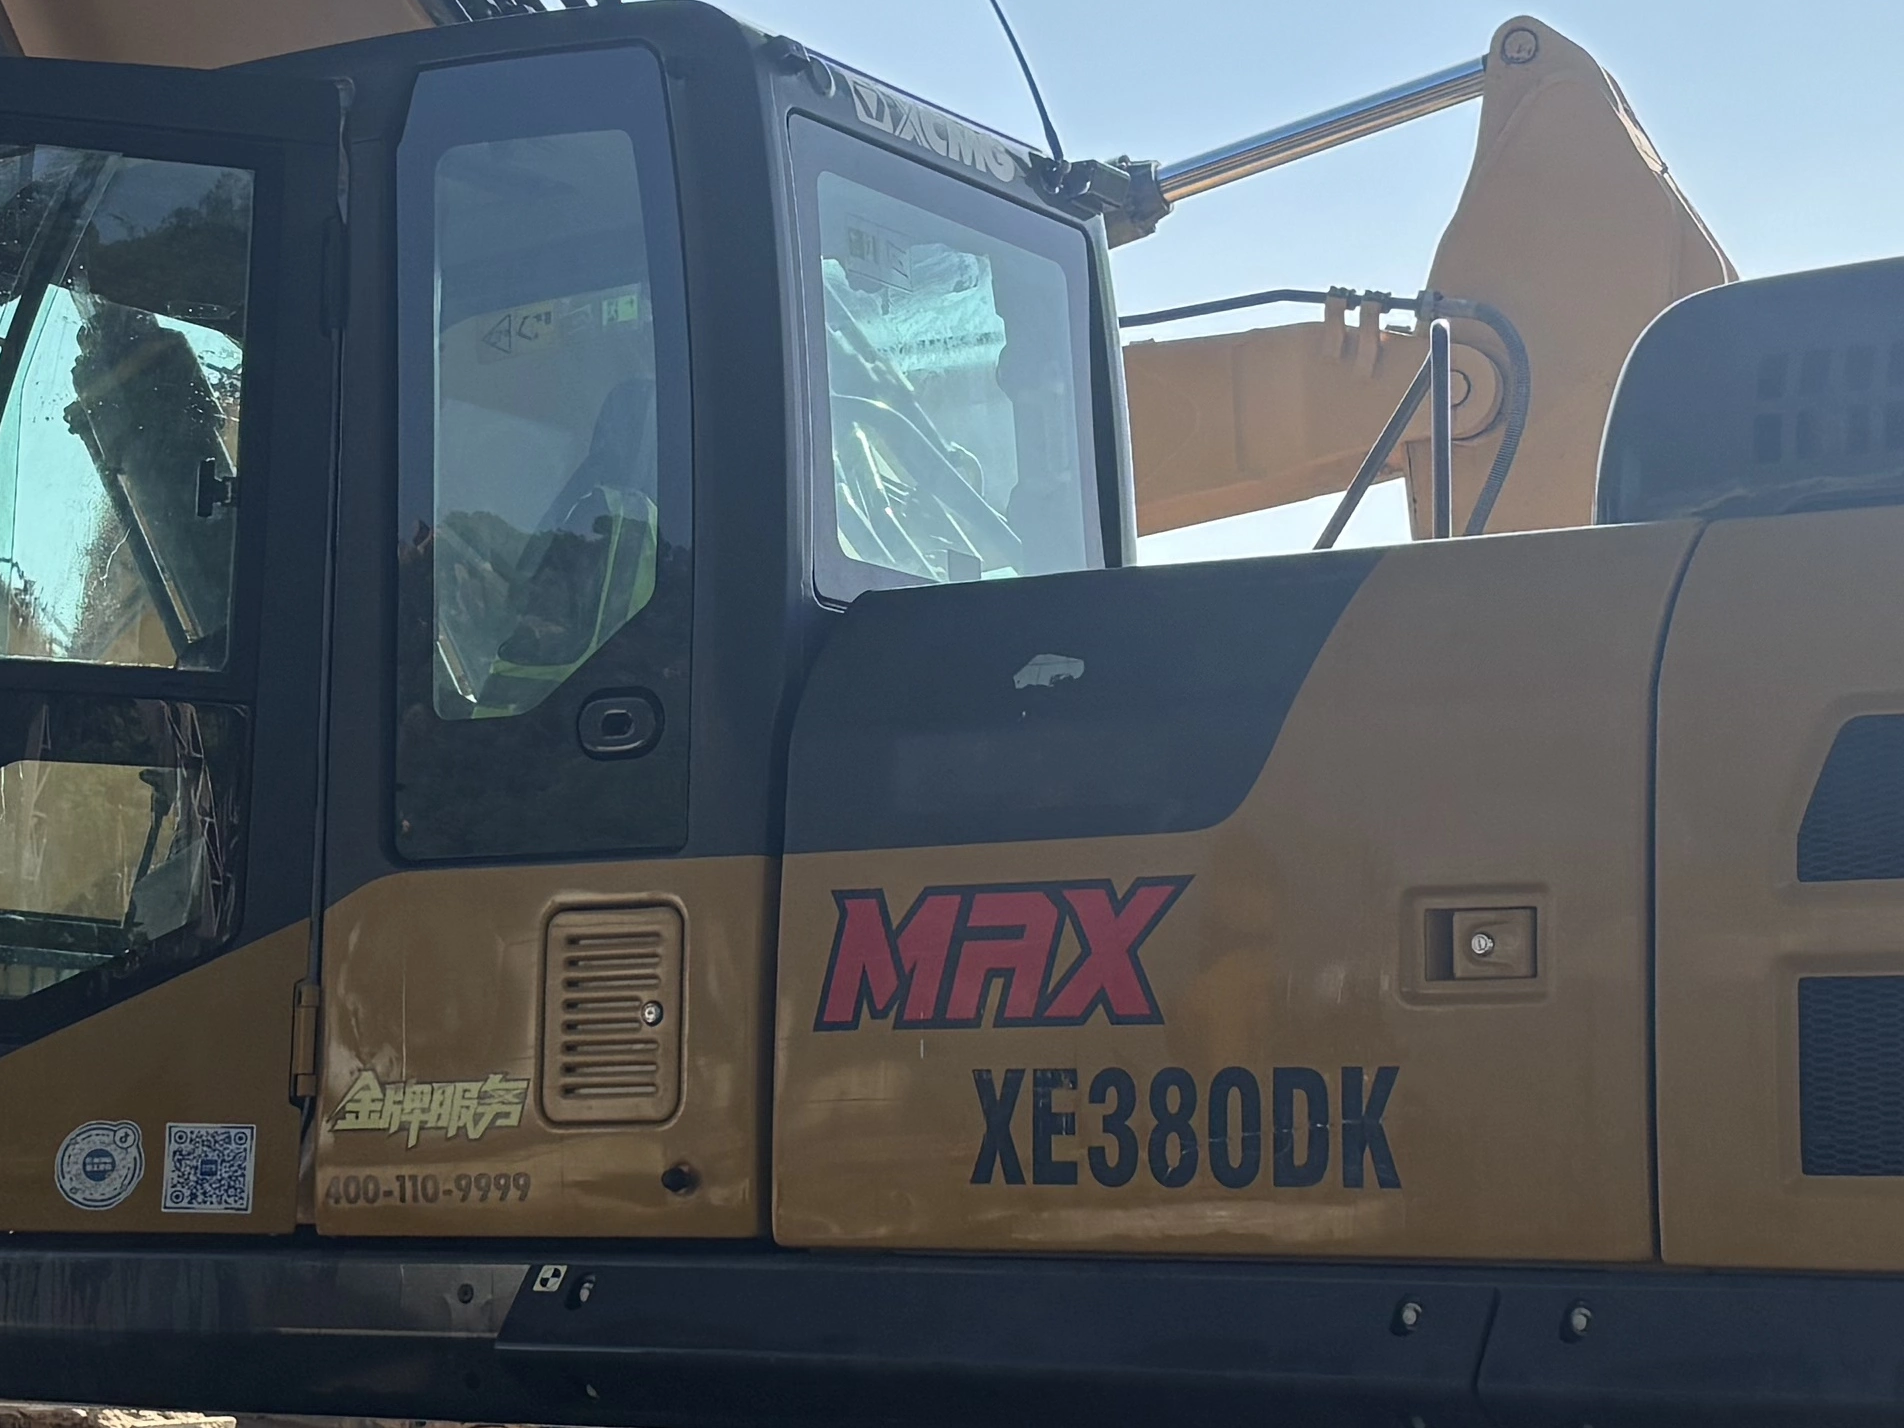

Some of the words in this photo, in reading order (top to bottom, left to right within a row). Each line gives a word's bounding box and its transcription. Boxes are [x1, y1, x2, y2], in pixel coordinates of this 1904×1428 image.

[894, 98, 1015, 183] XCMG
[813, 874, 1195, 1031] MAX
[327, 1070, 530, 1149] 金牌服务
[970, 1066, 1402, 1189] XE380DK
[325, 1172, 531, 1205] 400-110-9999
